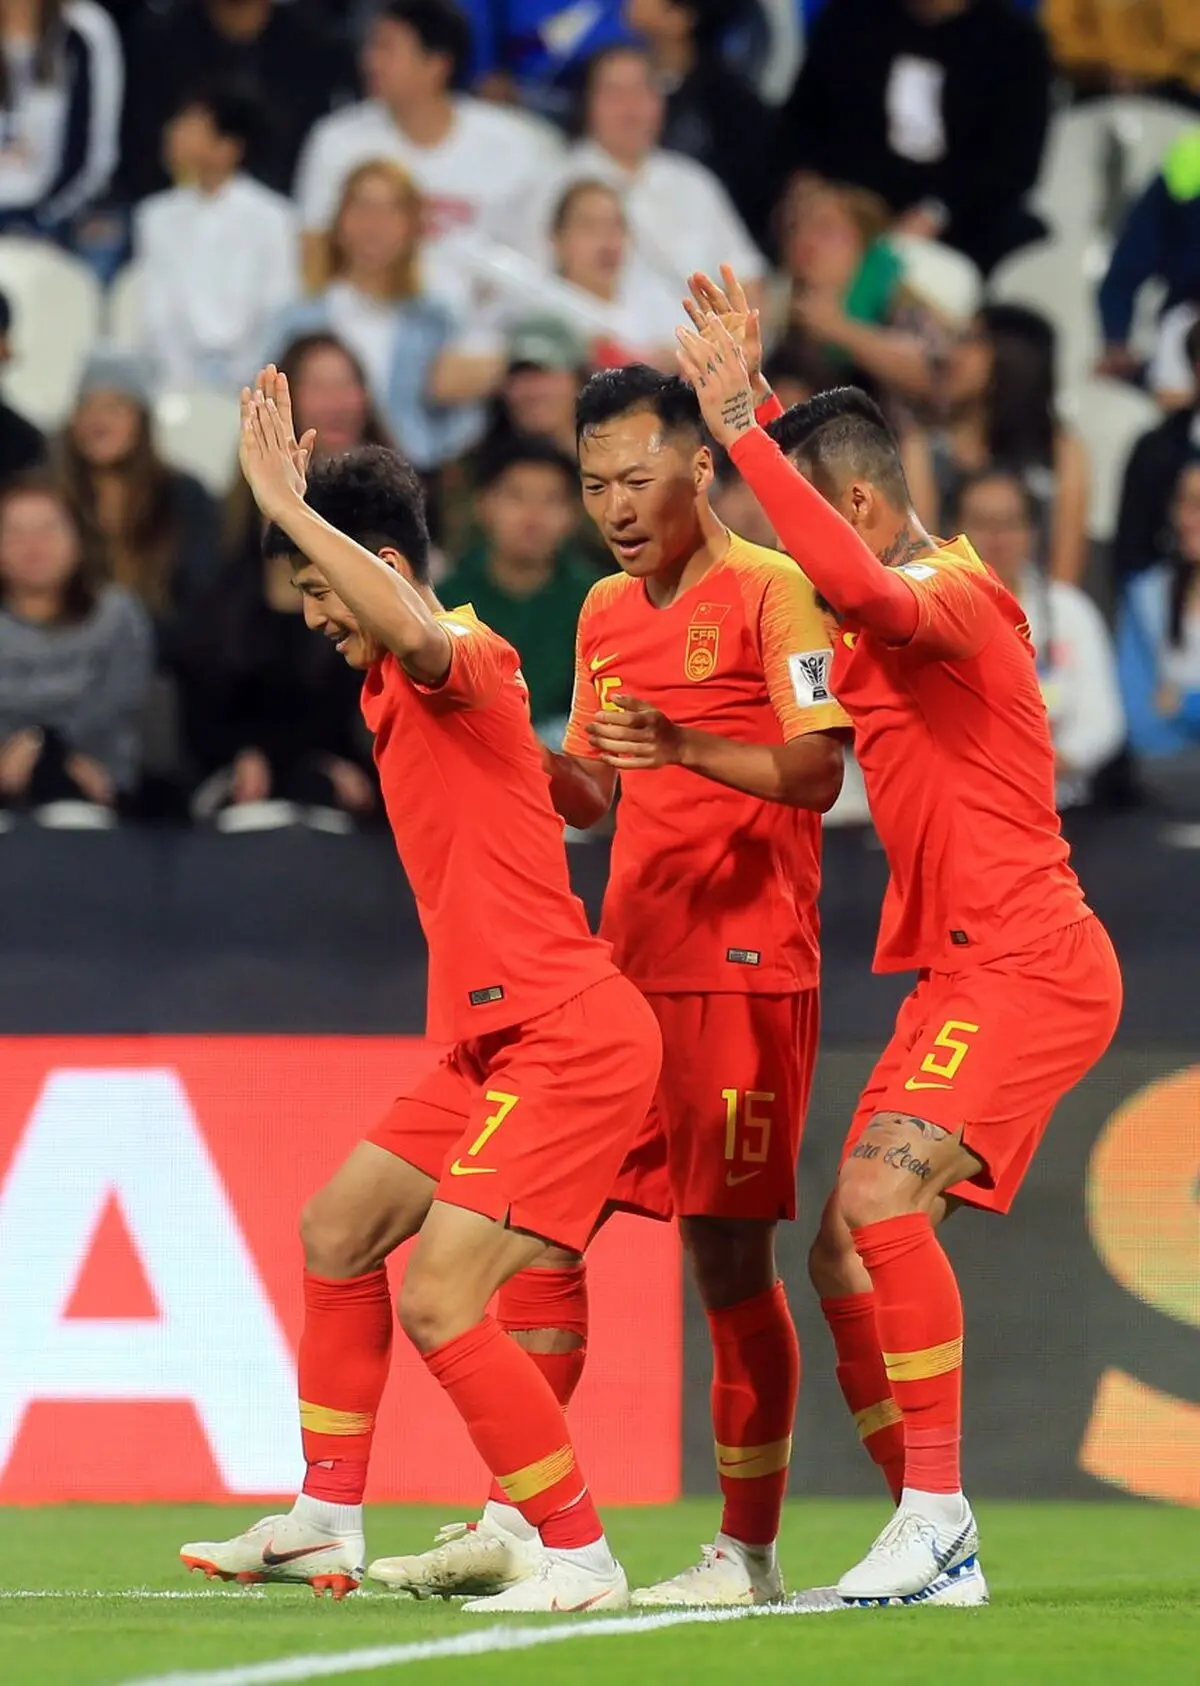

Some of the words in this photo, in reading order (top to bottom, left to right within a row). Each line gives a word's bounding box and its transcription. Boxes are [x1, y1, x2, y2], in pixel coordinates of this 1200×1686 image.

[691, 630, 716, 641] CFA
[920, 1019, 980, 1080] 5
[467, 1089, 521, 1157] 7
[721, 1088, 776, 1163] 15
[0, 1066, 303, 1496] A
